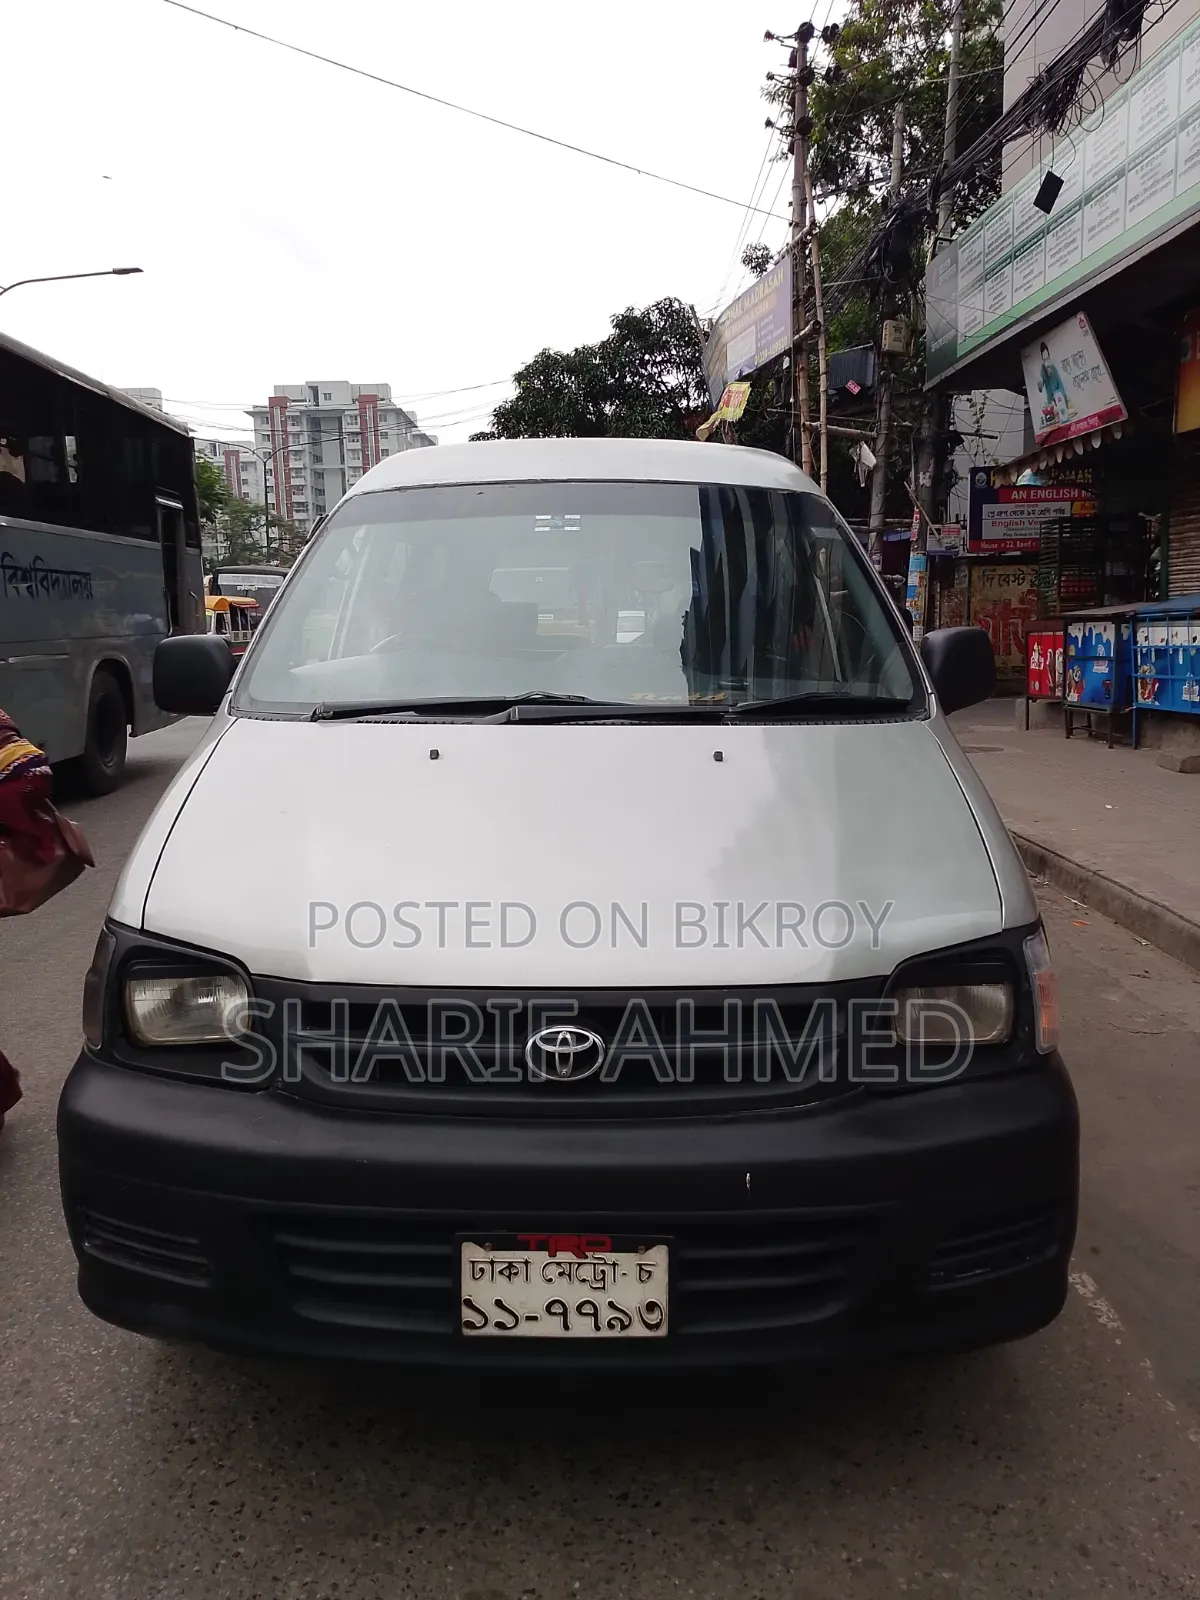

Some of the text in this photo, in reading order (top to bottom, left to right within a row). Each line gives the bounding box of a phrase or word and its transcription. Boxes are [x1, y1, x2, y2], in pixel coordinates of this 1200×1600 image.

[1011, 490, 1026, 500] AN
[1030, 488, 1079, 499] ENGLISH
[991, 519, 1025, 529] English
[980, 541, 998, 549] House
[517, 1234, 613, 1259] TRD
[469, 1255, 532, 1283] ঢাকা
